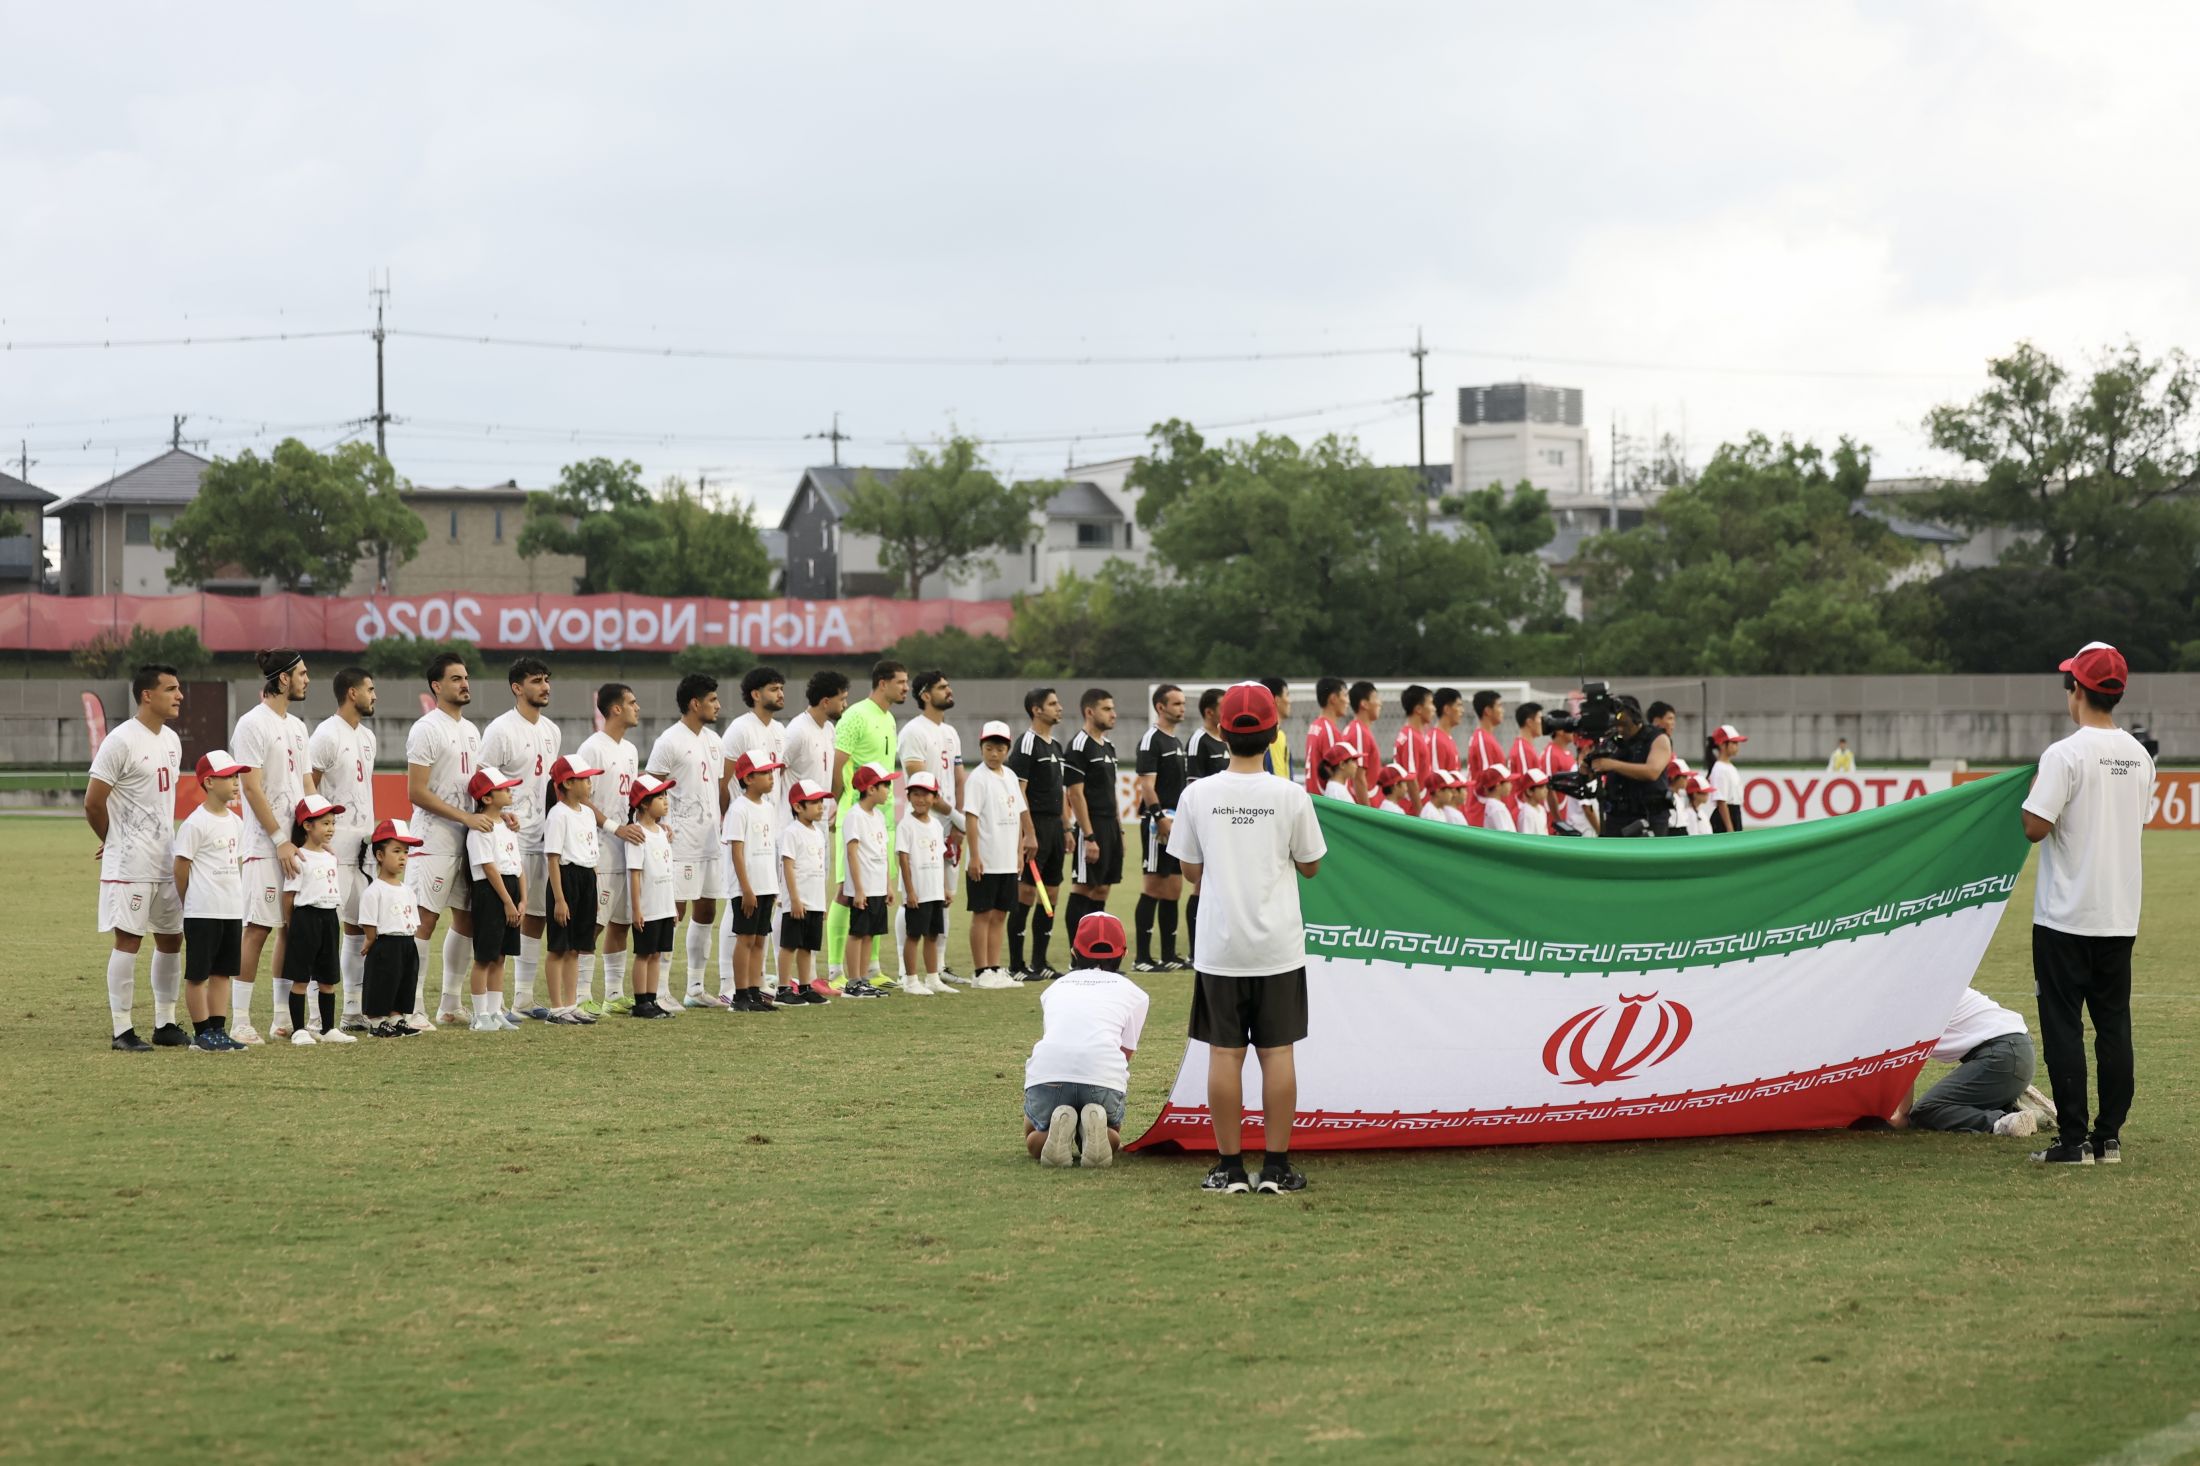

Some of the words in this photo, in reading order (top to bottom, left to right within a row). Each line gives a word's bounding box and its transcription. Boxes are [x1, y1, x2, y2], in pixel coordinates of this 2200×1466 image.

[461, 751, 469, 774] 11
[2099, 757, 2141, 768] Aichi-Nagoya
[157, 767, 170, 792] 10
[1212, 806, 1275, 817] Aichi-Nagoya
[1231, 817, 1255, 825] 2026
